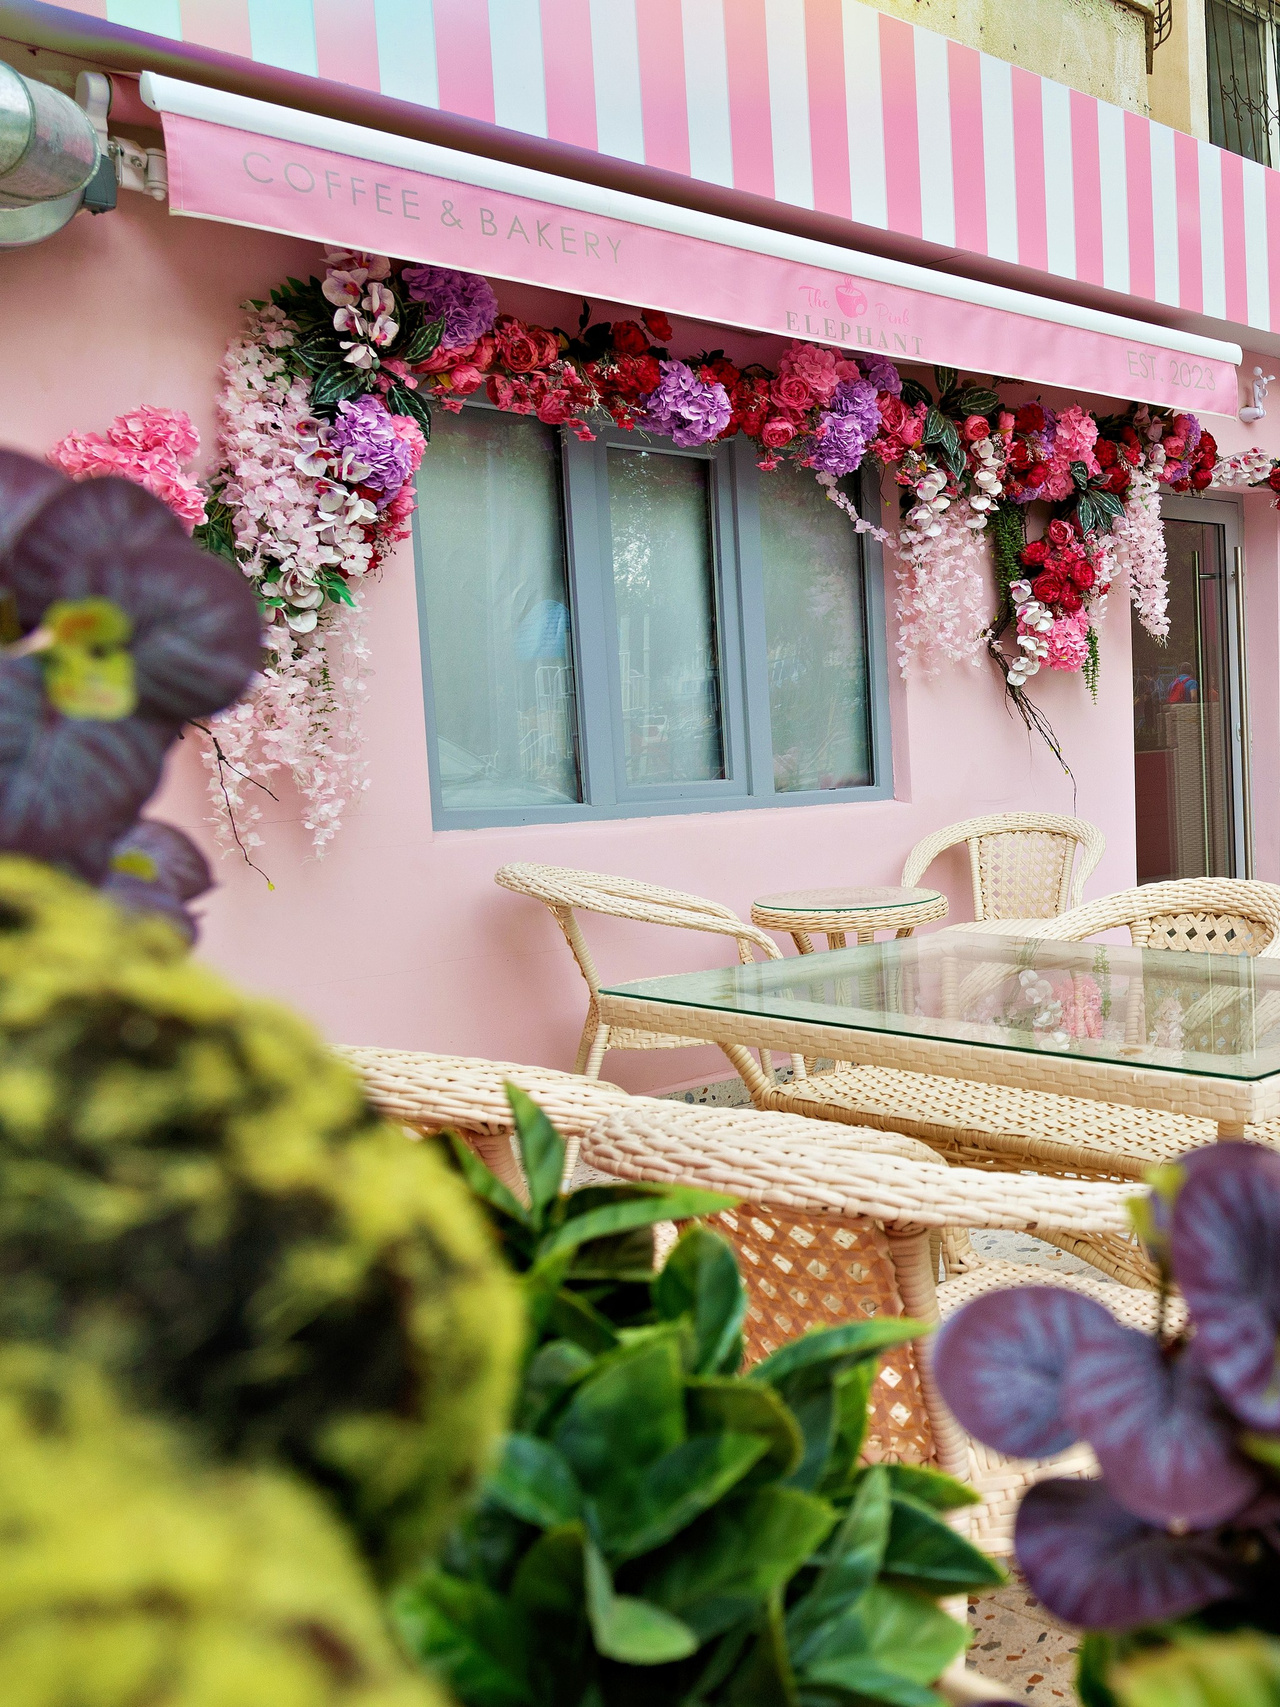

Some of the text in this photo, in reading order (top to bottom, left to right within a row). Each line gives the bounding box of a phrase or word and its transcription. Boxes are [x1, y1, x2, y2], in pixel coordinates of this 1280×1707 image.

[243, 151, 622, 264] COFFEE & BAKERY
[798, 285, 911, 326] The Pink
[785, 310, 924, 356] ELEPHANT
[1127, 350, 1217, 392] EST. 2023
